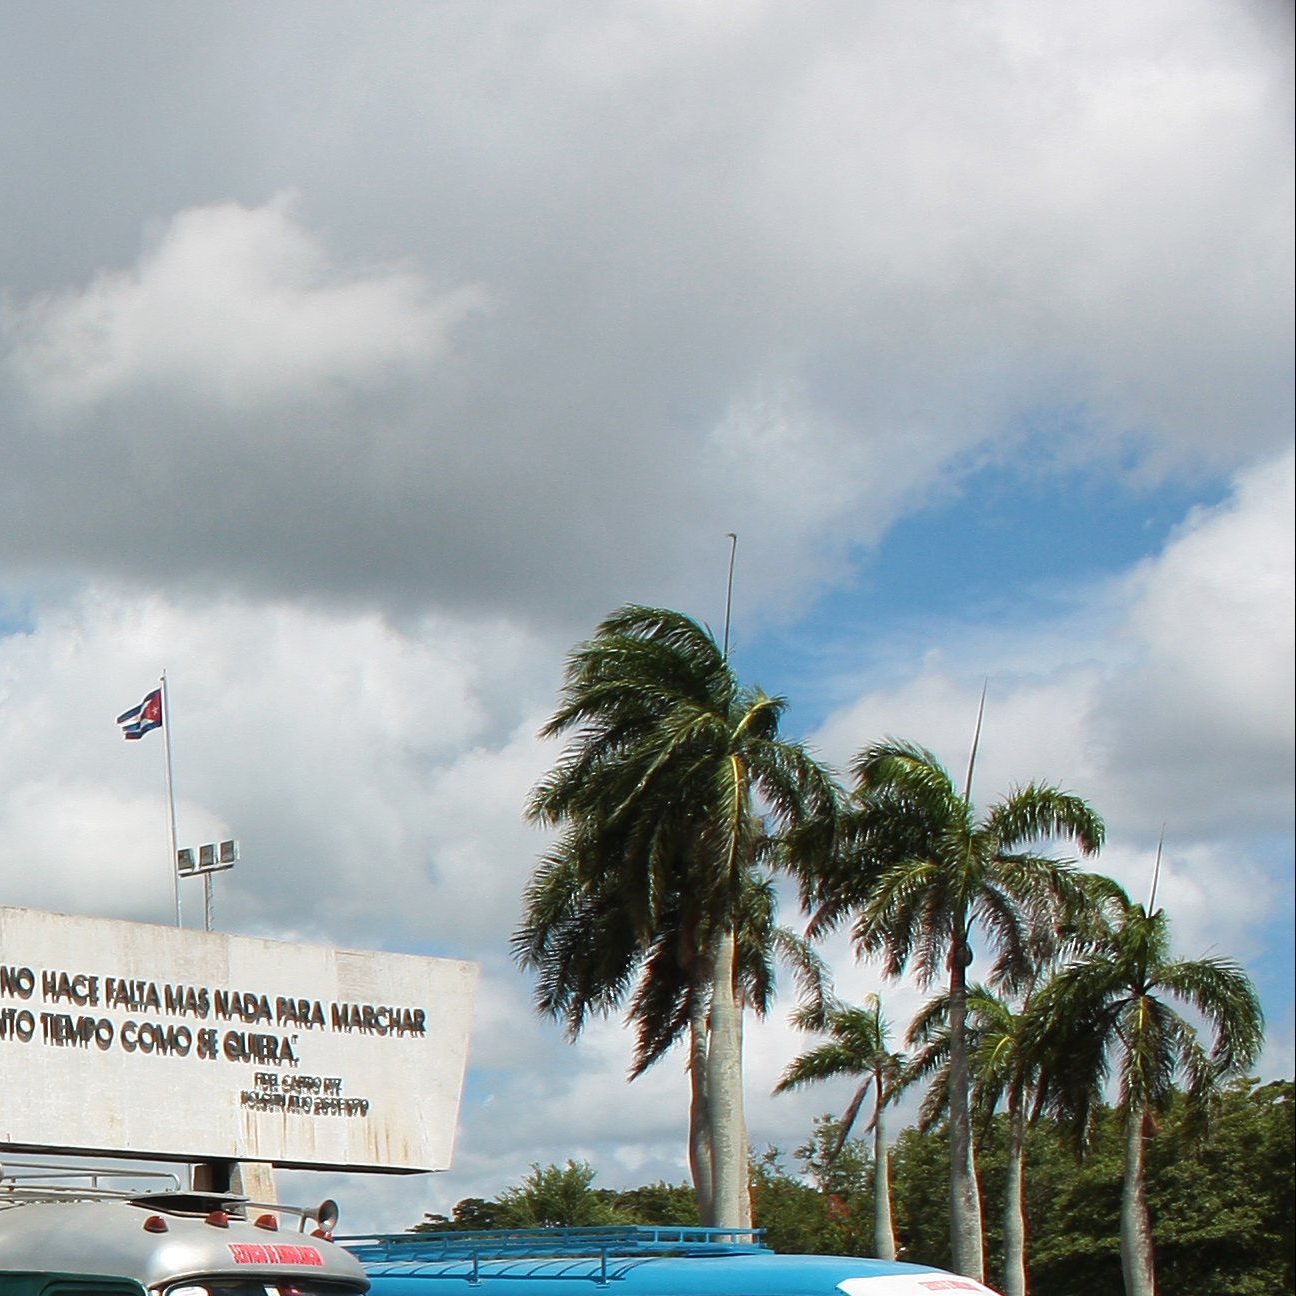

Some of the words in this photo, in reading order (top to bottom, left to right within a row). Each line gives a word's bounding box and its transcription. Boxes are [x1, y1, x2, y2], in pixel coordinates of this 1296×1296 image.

[0, 965, 35, 1000] NO
[42, 970, 98, 1007] HACE
[105, 977, 160, 1014] FALTA
[164, 984, 209, 1019] MAS
[214, 989, 272, 1026] NADA
[276, 996, 326, 1031] PARA
[331, 1003, 426, 1038] MARCHAR
[40, 1012, 114, 1051] TIEMPO
[121, 1020, 192, 1057] COMO
[197, 1028, 218, 1060] SE
